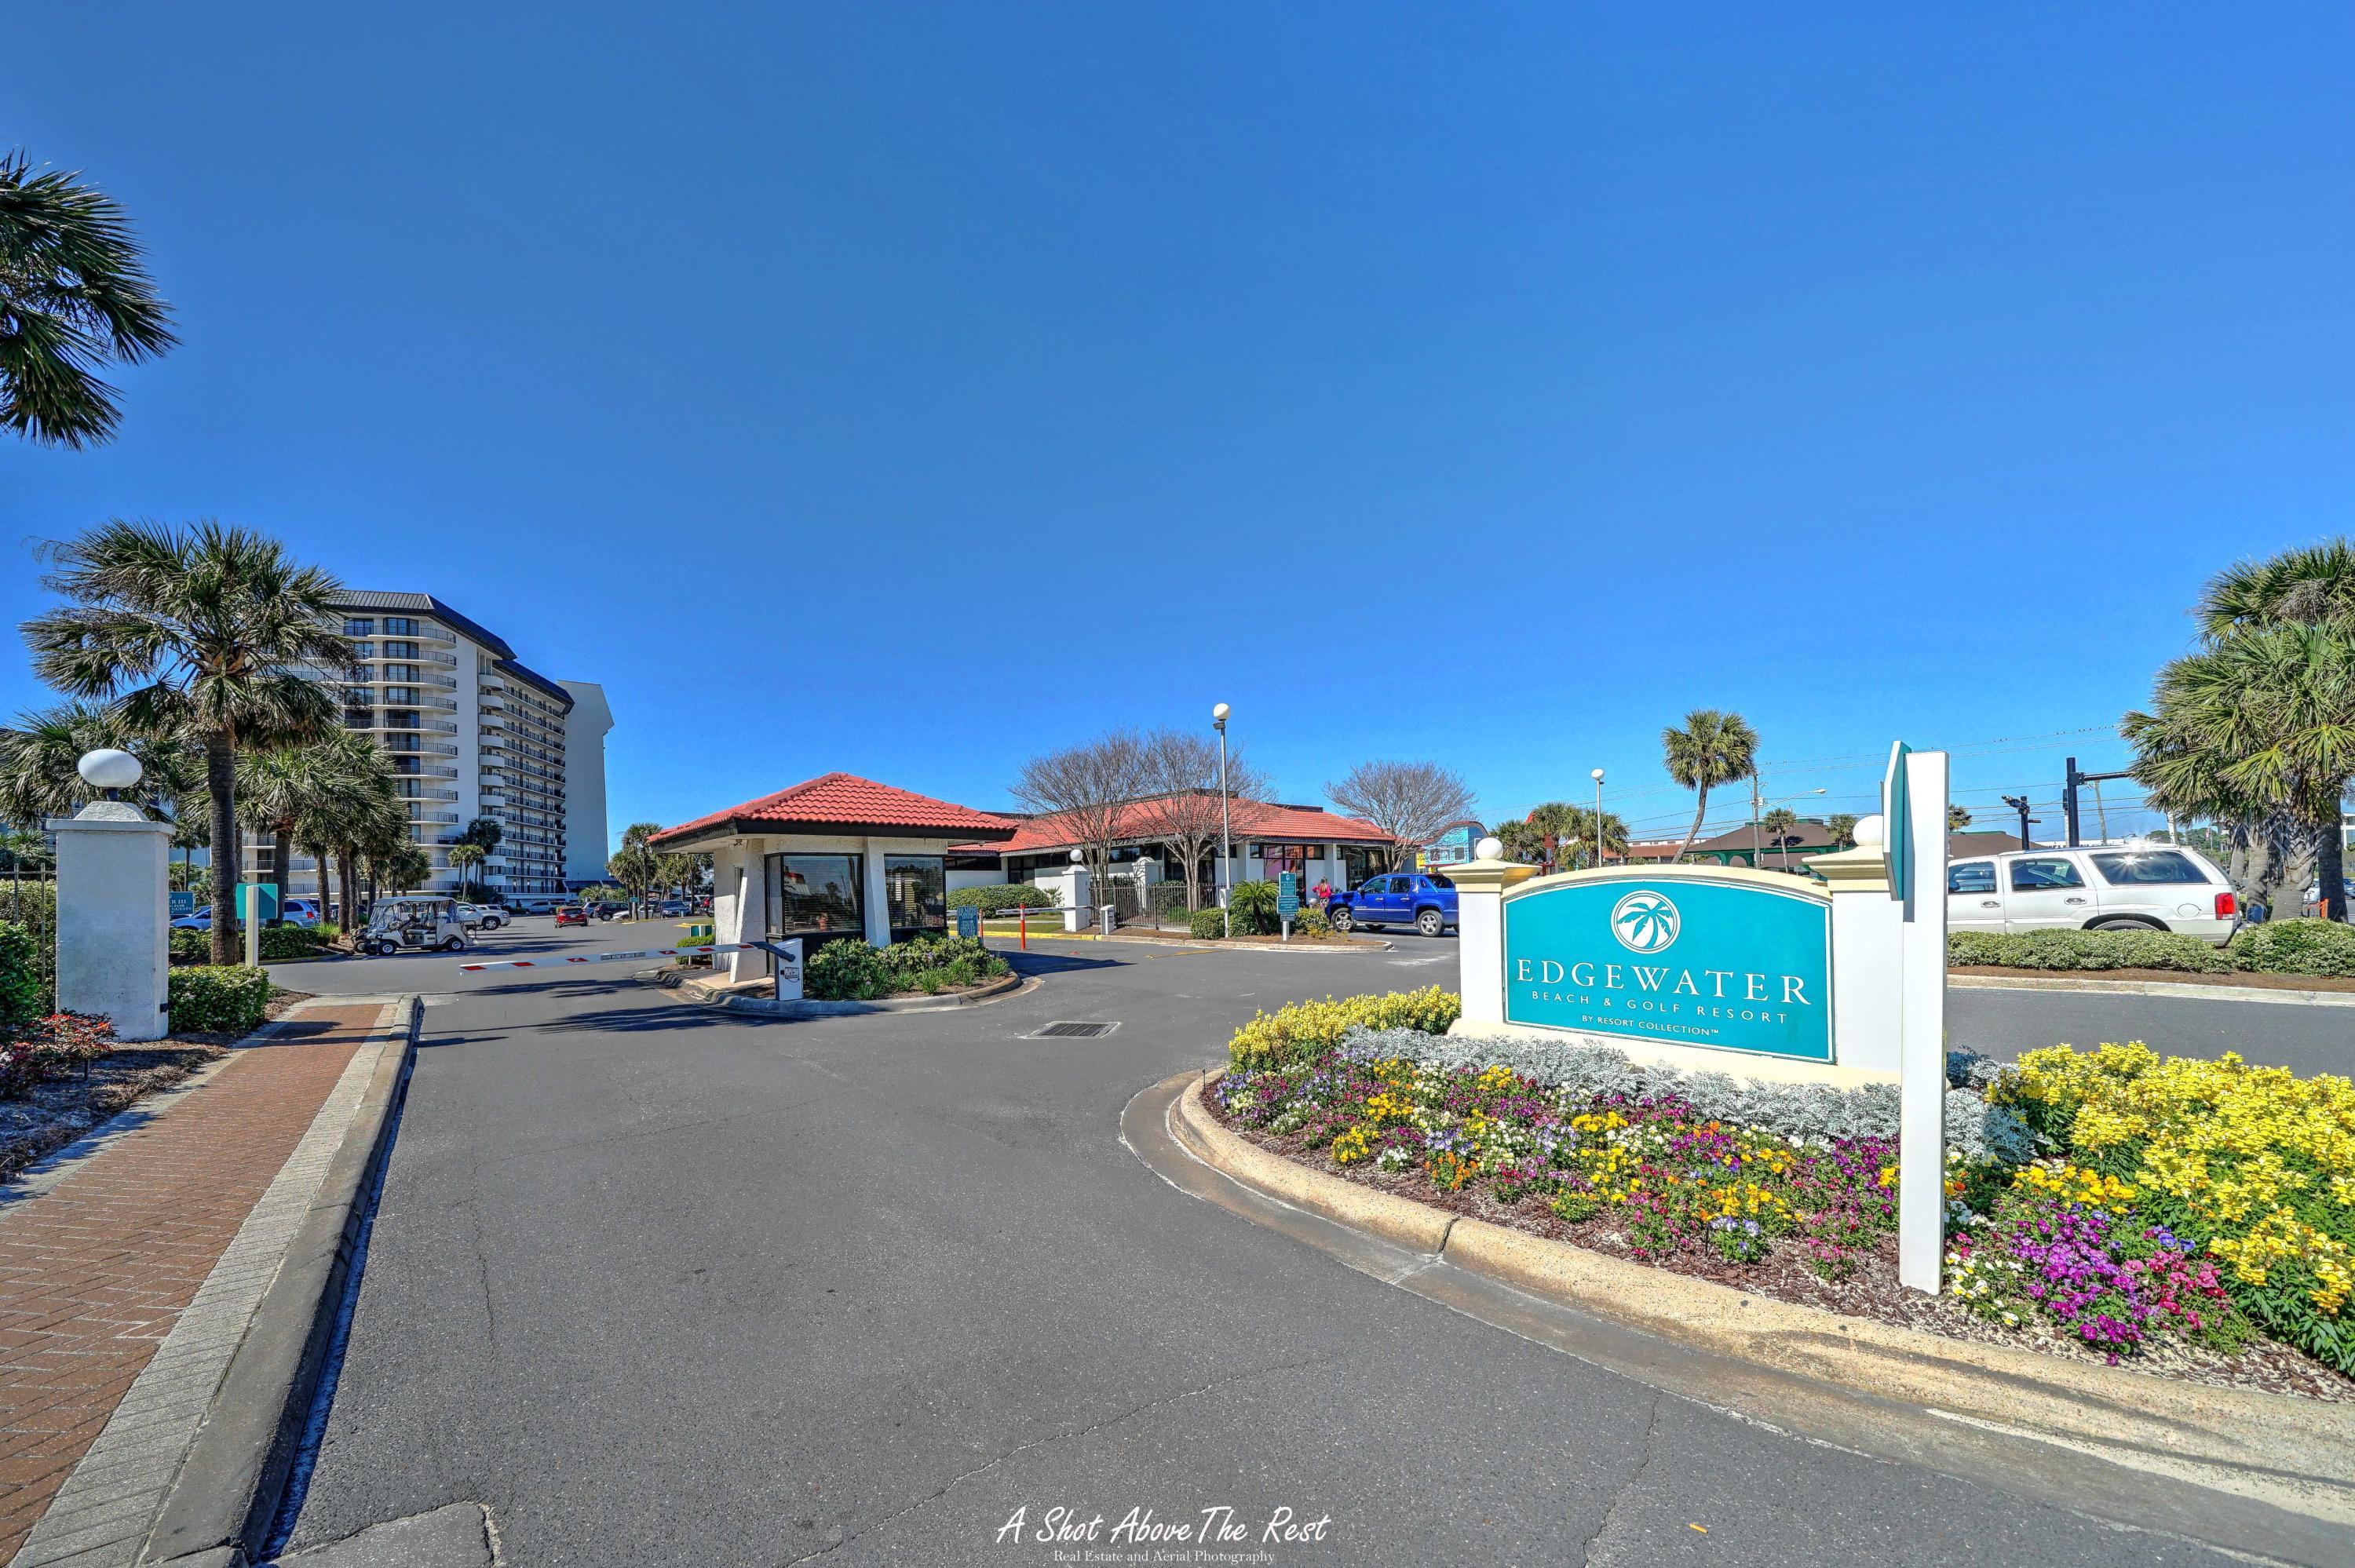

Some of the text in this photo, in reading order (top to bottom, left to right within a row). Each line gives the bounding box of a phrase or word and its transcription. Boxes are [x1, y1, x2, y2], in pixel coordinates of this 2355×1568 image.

[1517, 959, 1812, 1005] EDGEWATER
[1532, 990, 1787, 1024] BEACH & GOLF RESORT
[1597, 1016, 1634, 1027] RESORT
